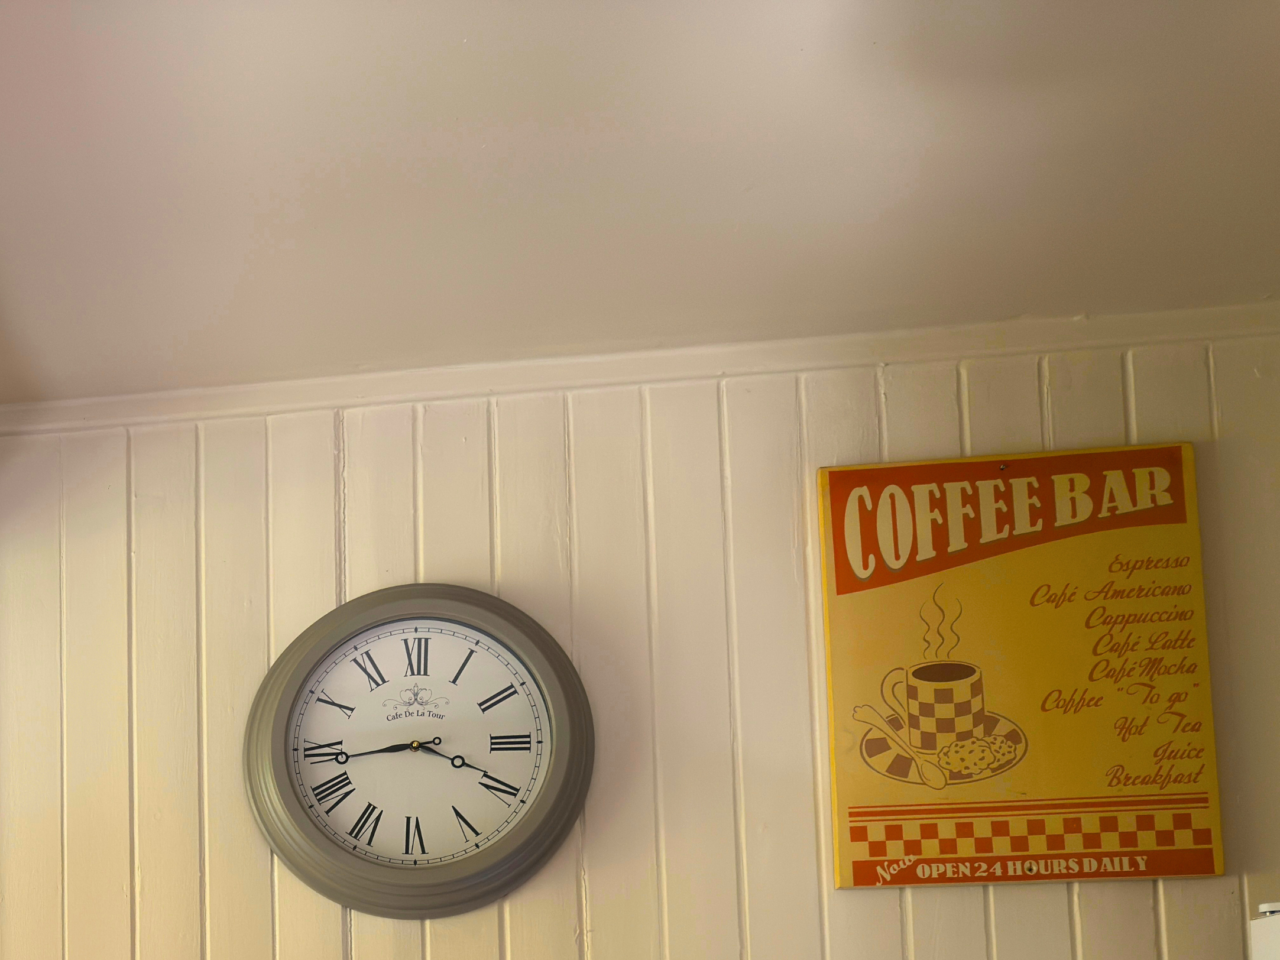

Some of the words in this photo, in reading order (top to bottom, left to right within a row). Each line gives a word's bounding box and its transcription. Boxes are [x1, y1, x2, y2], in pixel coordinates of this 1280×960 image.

[844, 476, 1043, 579] COFFEE
[1051, 466, 1174, 527] BAR
[1108, 553, 1190, 579] Espresso
[1030, 582, 1079, 609] Café
[1084, 580, 1192, 601] Americano
[1085, 605, 1194, 633] Cappuccino
[401, 637, 431, 678] XII
[1092, 632, 1141, 658] Café
[1145, 629, 1196, 651] Latte
[350, 649, 389, 692] XI
[449, 648, 477, 686] I
[1088, 657, 1138, 684] Café
[1138, 656, 1198, 682] Mocha
[316, 688, 356, 719] X
[477, 682, 519, 714] II
[1041, 688, 1104, 714] Coffee
[386, 711, 402, 721] Cafe
[404, 710, 414, 718] De
[416, 709, 425, 717] La
[427, 710, 445, 720] Tour
[1114, 716, 1150, 742] Hot
[1157, 711, 1202, 734] Tea
[489, 731, 531, 754] III
[1153, 741, 1205, 765] Juice
[1105, 763, 1206, 790] Breakfast
[310, 770, 356, 817] VIII
[345, 801, 383, 848] VII
[402, 816, 429, 855] VI
[451, 805, 482, 843] V
[875, 854, 917, 886] Now
[915, 862, 971, 879] OPEN
[974, 861, 1002, 877] 24
[1006, 857, 1080, 876] HOURS
[1082, 855, 1148, 873] DAILY
